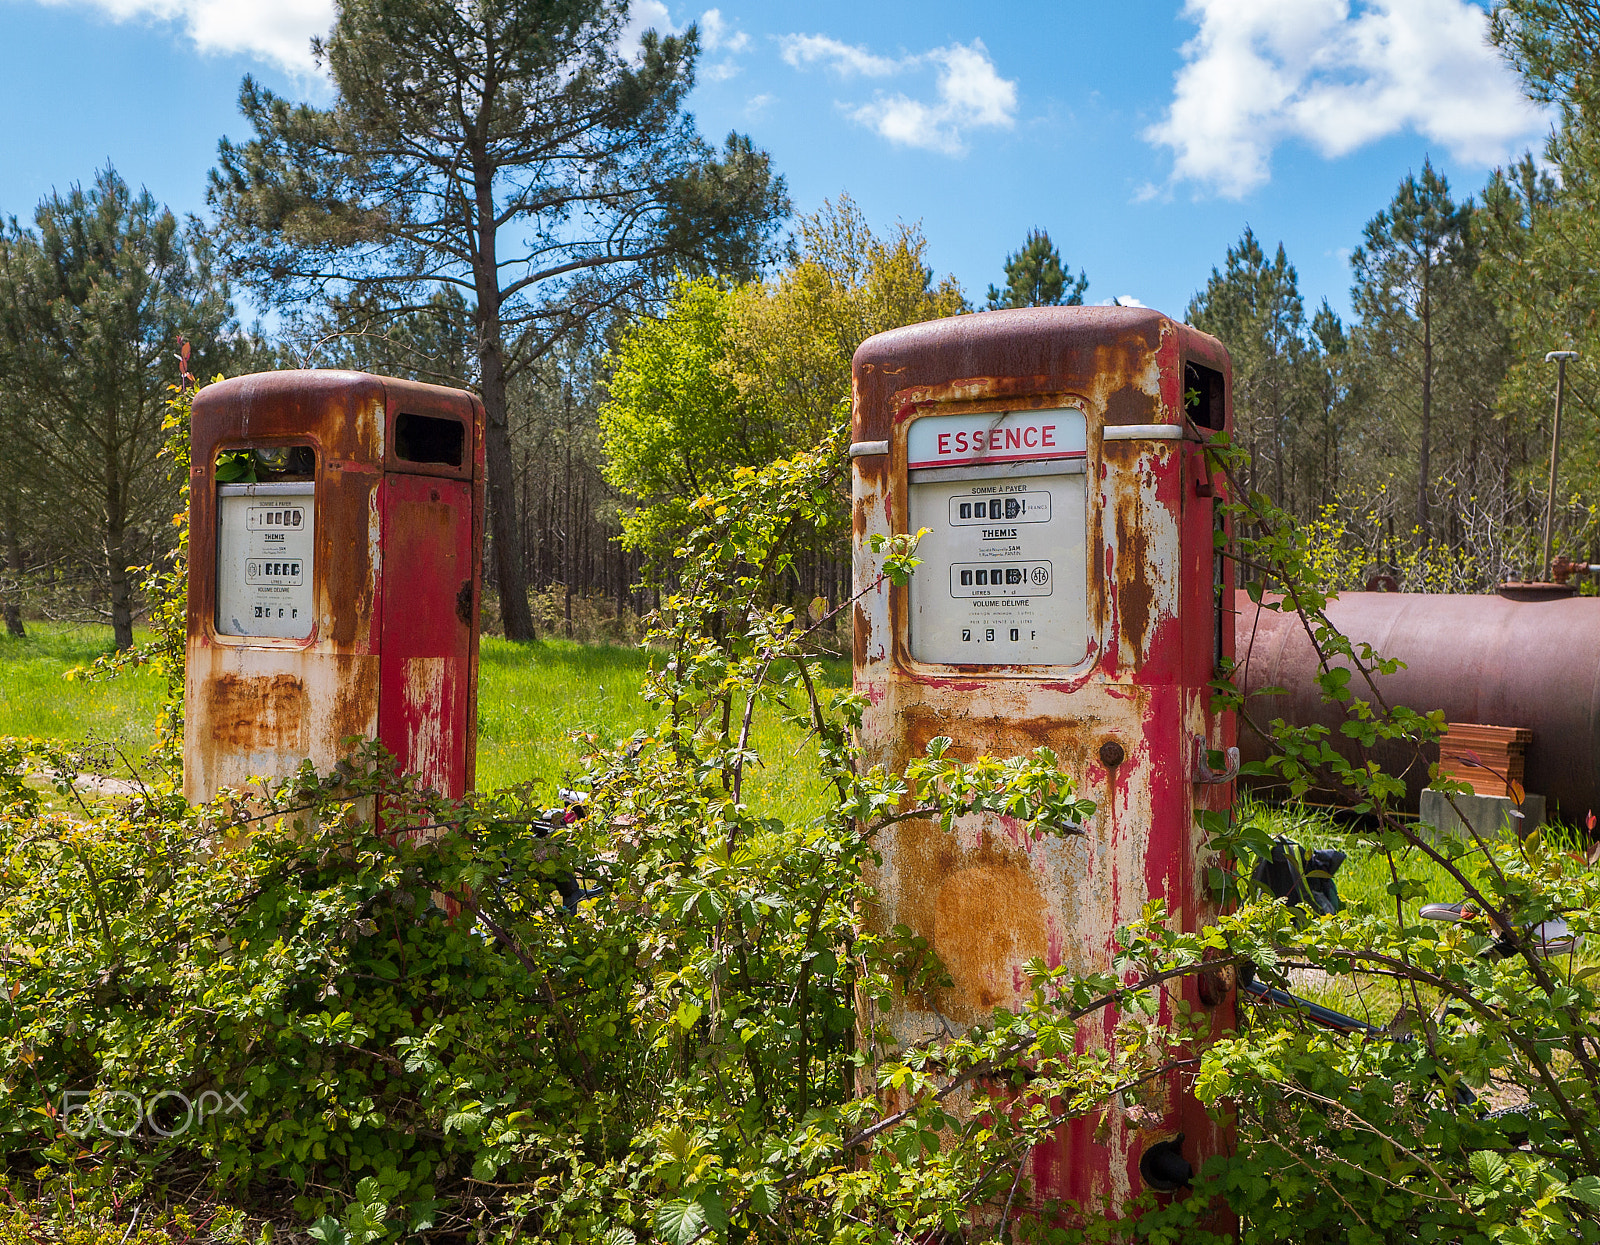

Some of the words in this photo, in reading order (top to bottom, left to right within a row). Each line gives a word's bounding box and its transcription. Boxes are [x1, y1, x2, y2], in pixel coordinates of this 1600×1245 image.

[938, 425, 1056, 455] ESSENCE
[972, 486, 997, 495] SOMME
[998, 485, 1004, 493] À
[1005, 484, 1027, 493] PAYER
[982, 528, 1017, 538] THEMIS
[972, 600, 1000, 608] VOLUME
[1031, 630, 1036, 641] F
